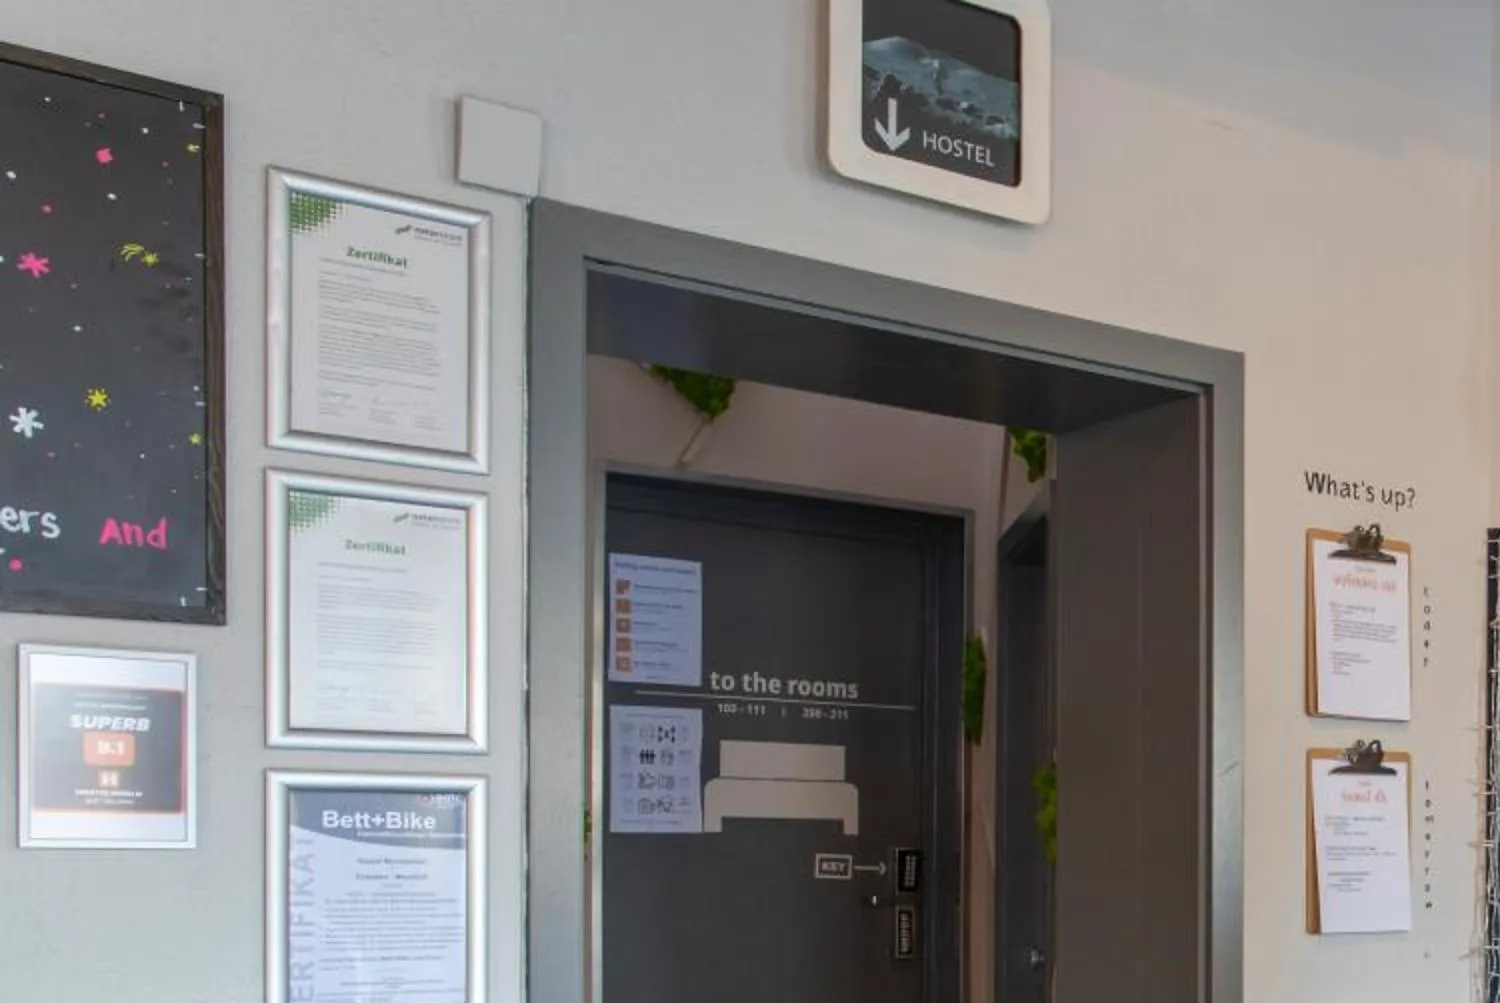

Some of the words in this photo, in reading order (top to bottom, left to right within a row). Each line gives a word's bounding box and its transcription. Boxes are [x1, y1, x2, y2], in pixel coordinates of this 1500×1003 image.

[923, 131, 995, 167] HOSTEL
[346, 246, 408, 268] Zertifikat
[1304, 469, 1375, 503] What's
[1381, 487, 1416, 512] up?
[99, 516, 167, 549] And
[344, 538, 406, 556] Zertifikat
[710, 671, 735, 691] to
[743, 671, 781, 694] the
[787, 679, 859, 699] rooms
[69, 714, 152, 733] SUPERB
[322, 809, 437, 830] Bett+Bike
